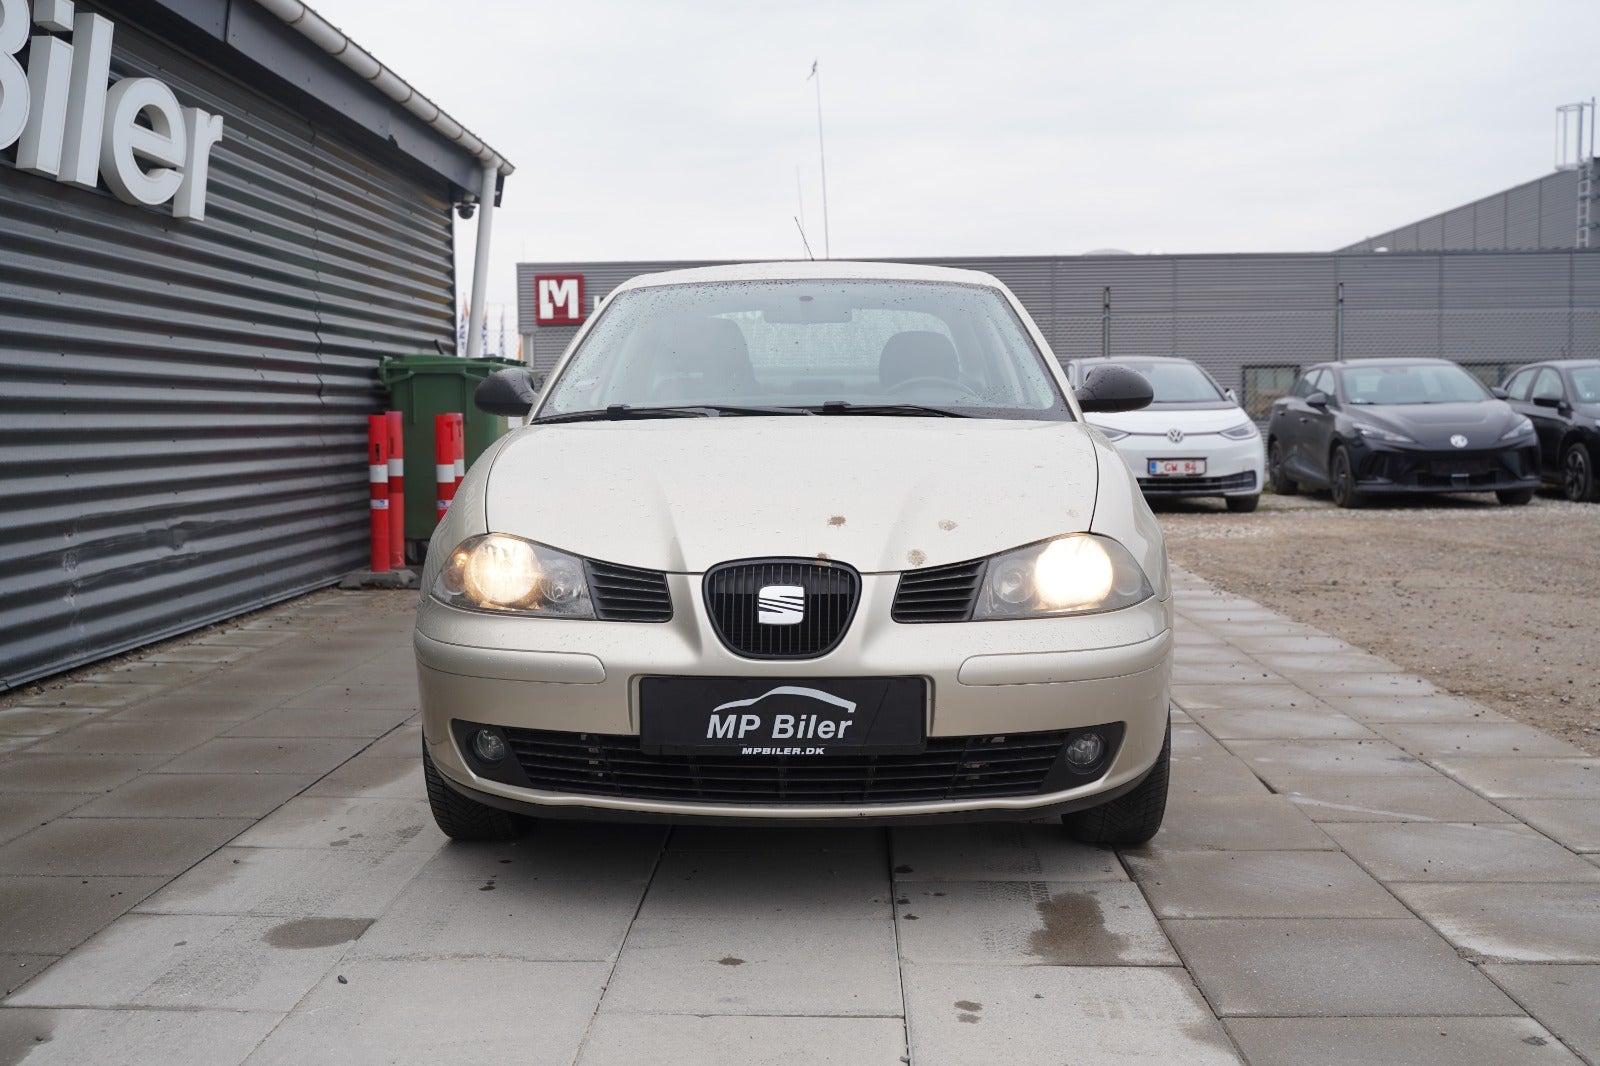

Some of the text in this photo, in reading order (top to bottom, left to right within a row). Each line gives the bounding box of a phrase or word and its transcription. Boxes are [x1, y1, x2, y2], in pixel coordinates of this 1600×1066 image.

[706, 714, 853, 739] MP Biler
[741, 747, 825, 755] MPBILER.DK
